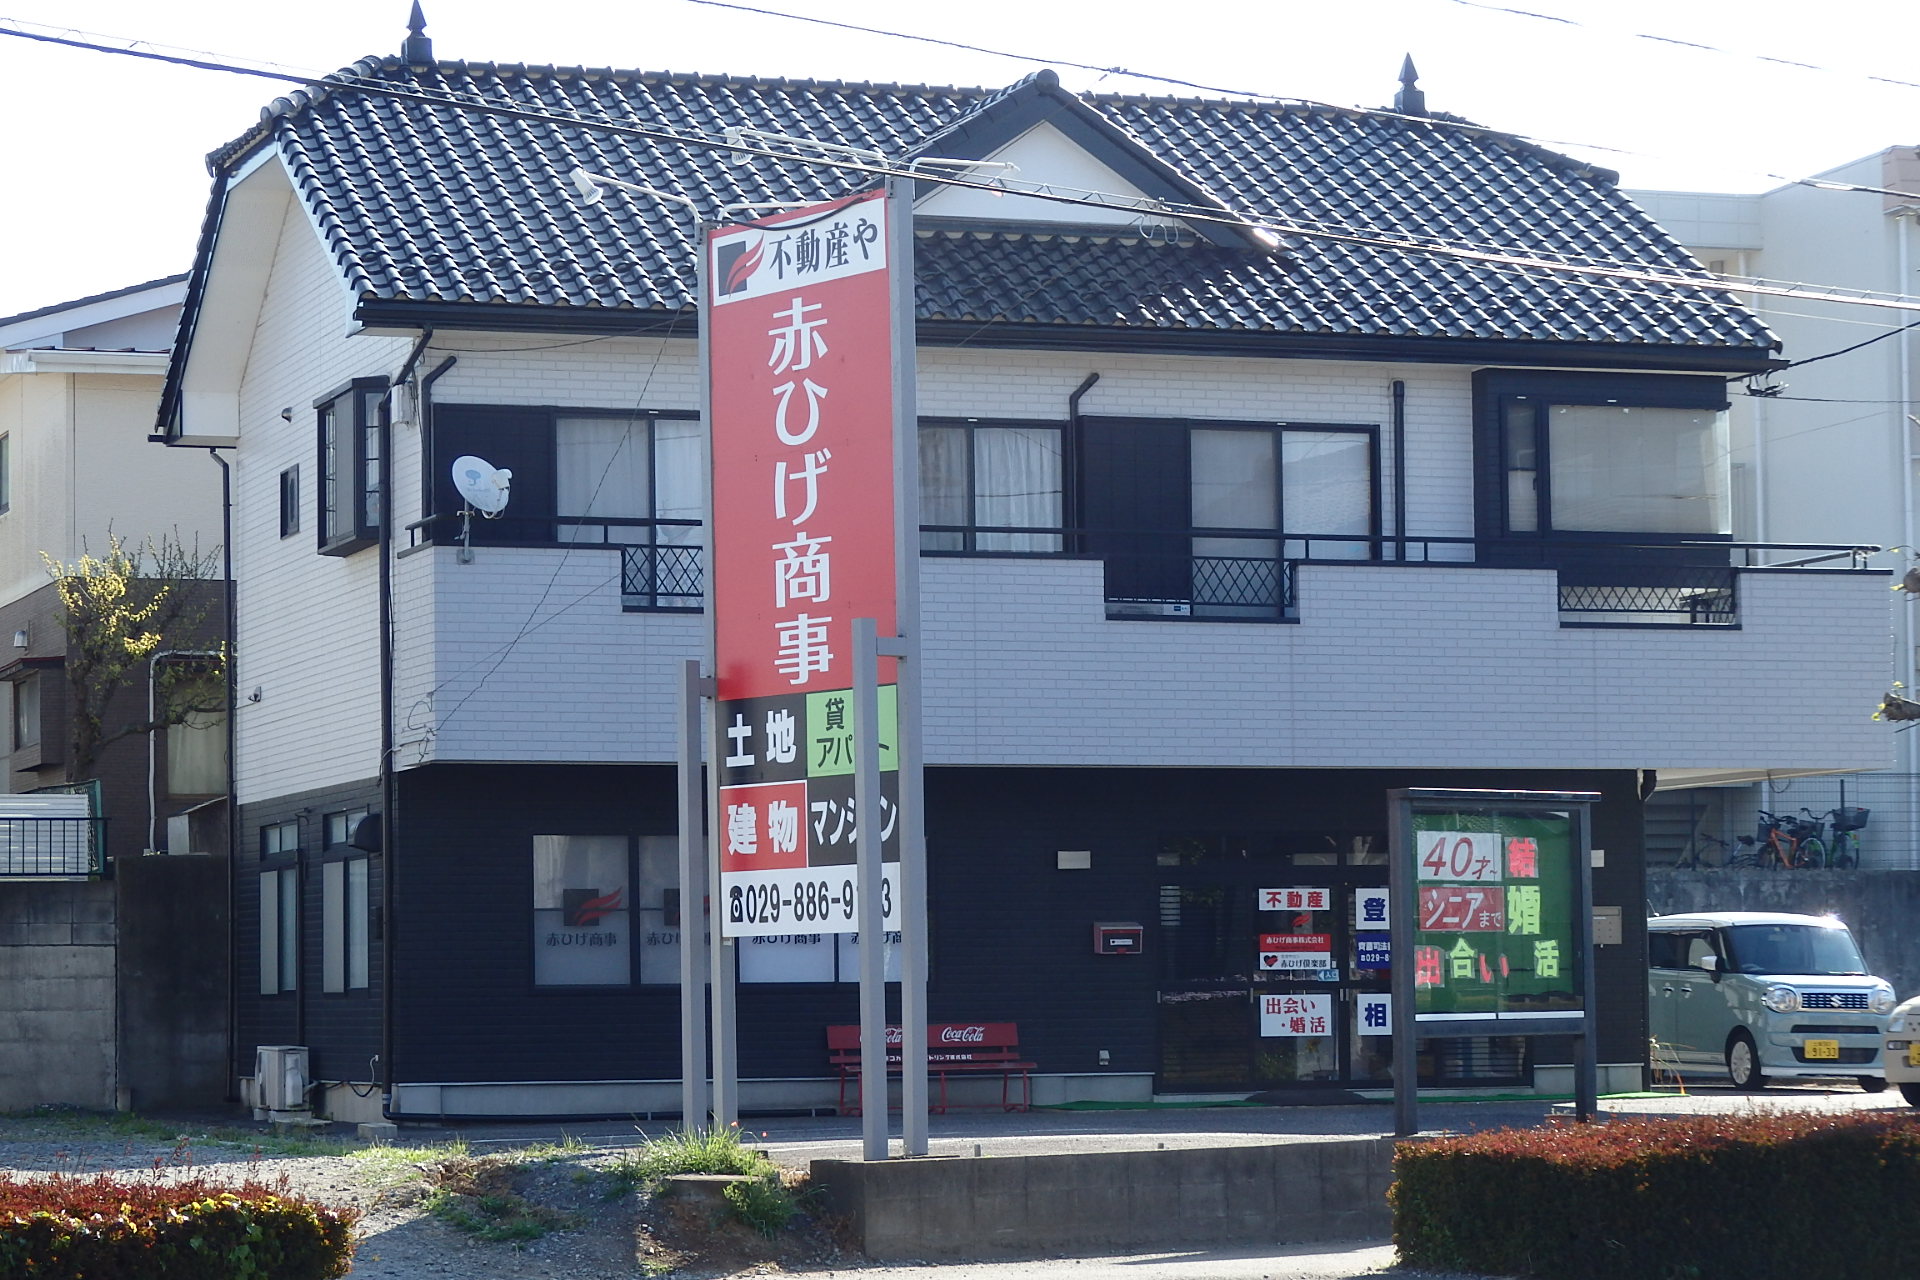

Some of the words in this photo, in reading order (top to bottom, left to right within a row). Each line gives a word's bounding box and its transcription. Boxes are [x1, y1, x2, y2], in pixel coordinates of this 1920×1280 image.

[769, 217, 878, 280] 不動産や
[768, 297, 834, 685] 赤ひげ商事
[726, 709, 797, 768] 土地
[727, 800, 798, 856] 建物
[811, 795, 897, 846] マンシン
[746, 878, 892, 923] 029-886-93
[1266, 891, 1323, 908] 不動産
[1427, 889, 1502, 929] シニアまで
[546, 932, 617, 947] 赤ひげ商事
[1266, 997, 1316, 1014] 出会い
[1364, 1003, 1387, 1027] 相
[941, 1026, 985, 1042] Coca-Cola
